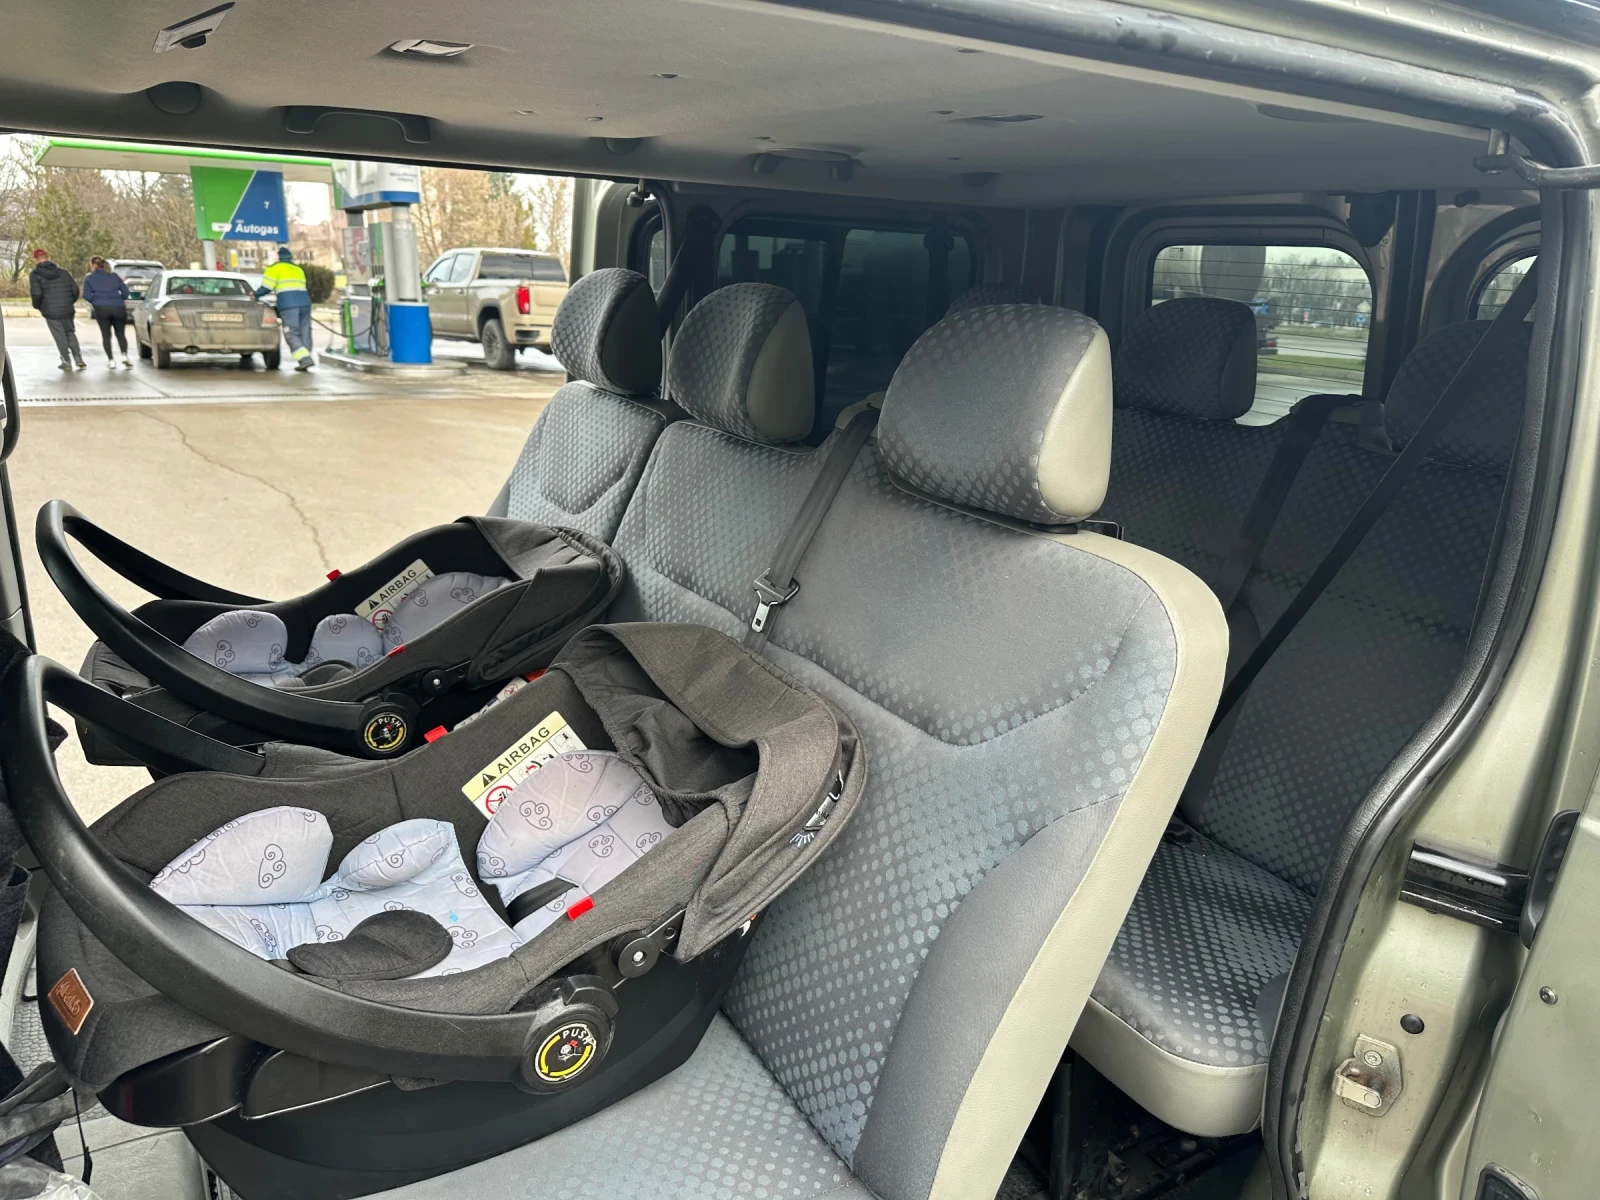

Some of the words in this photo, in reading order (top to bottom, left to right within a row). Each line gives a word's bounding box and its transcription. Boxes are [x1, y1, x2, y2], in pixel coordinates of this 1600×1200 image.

[234, 222, 279, 237] Autogas
[379, 569, 417, 602] AIRBAG
[378, 716, 402, 728] PUSH
[497, 726, 551, 774] AIRBAG
[562, 1028, 593, 1045] PUSH
